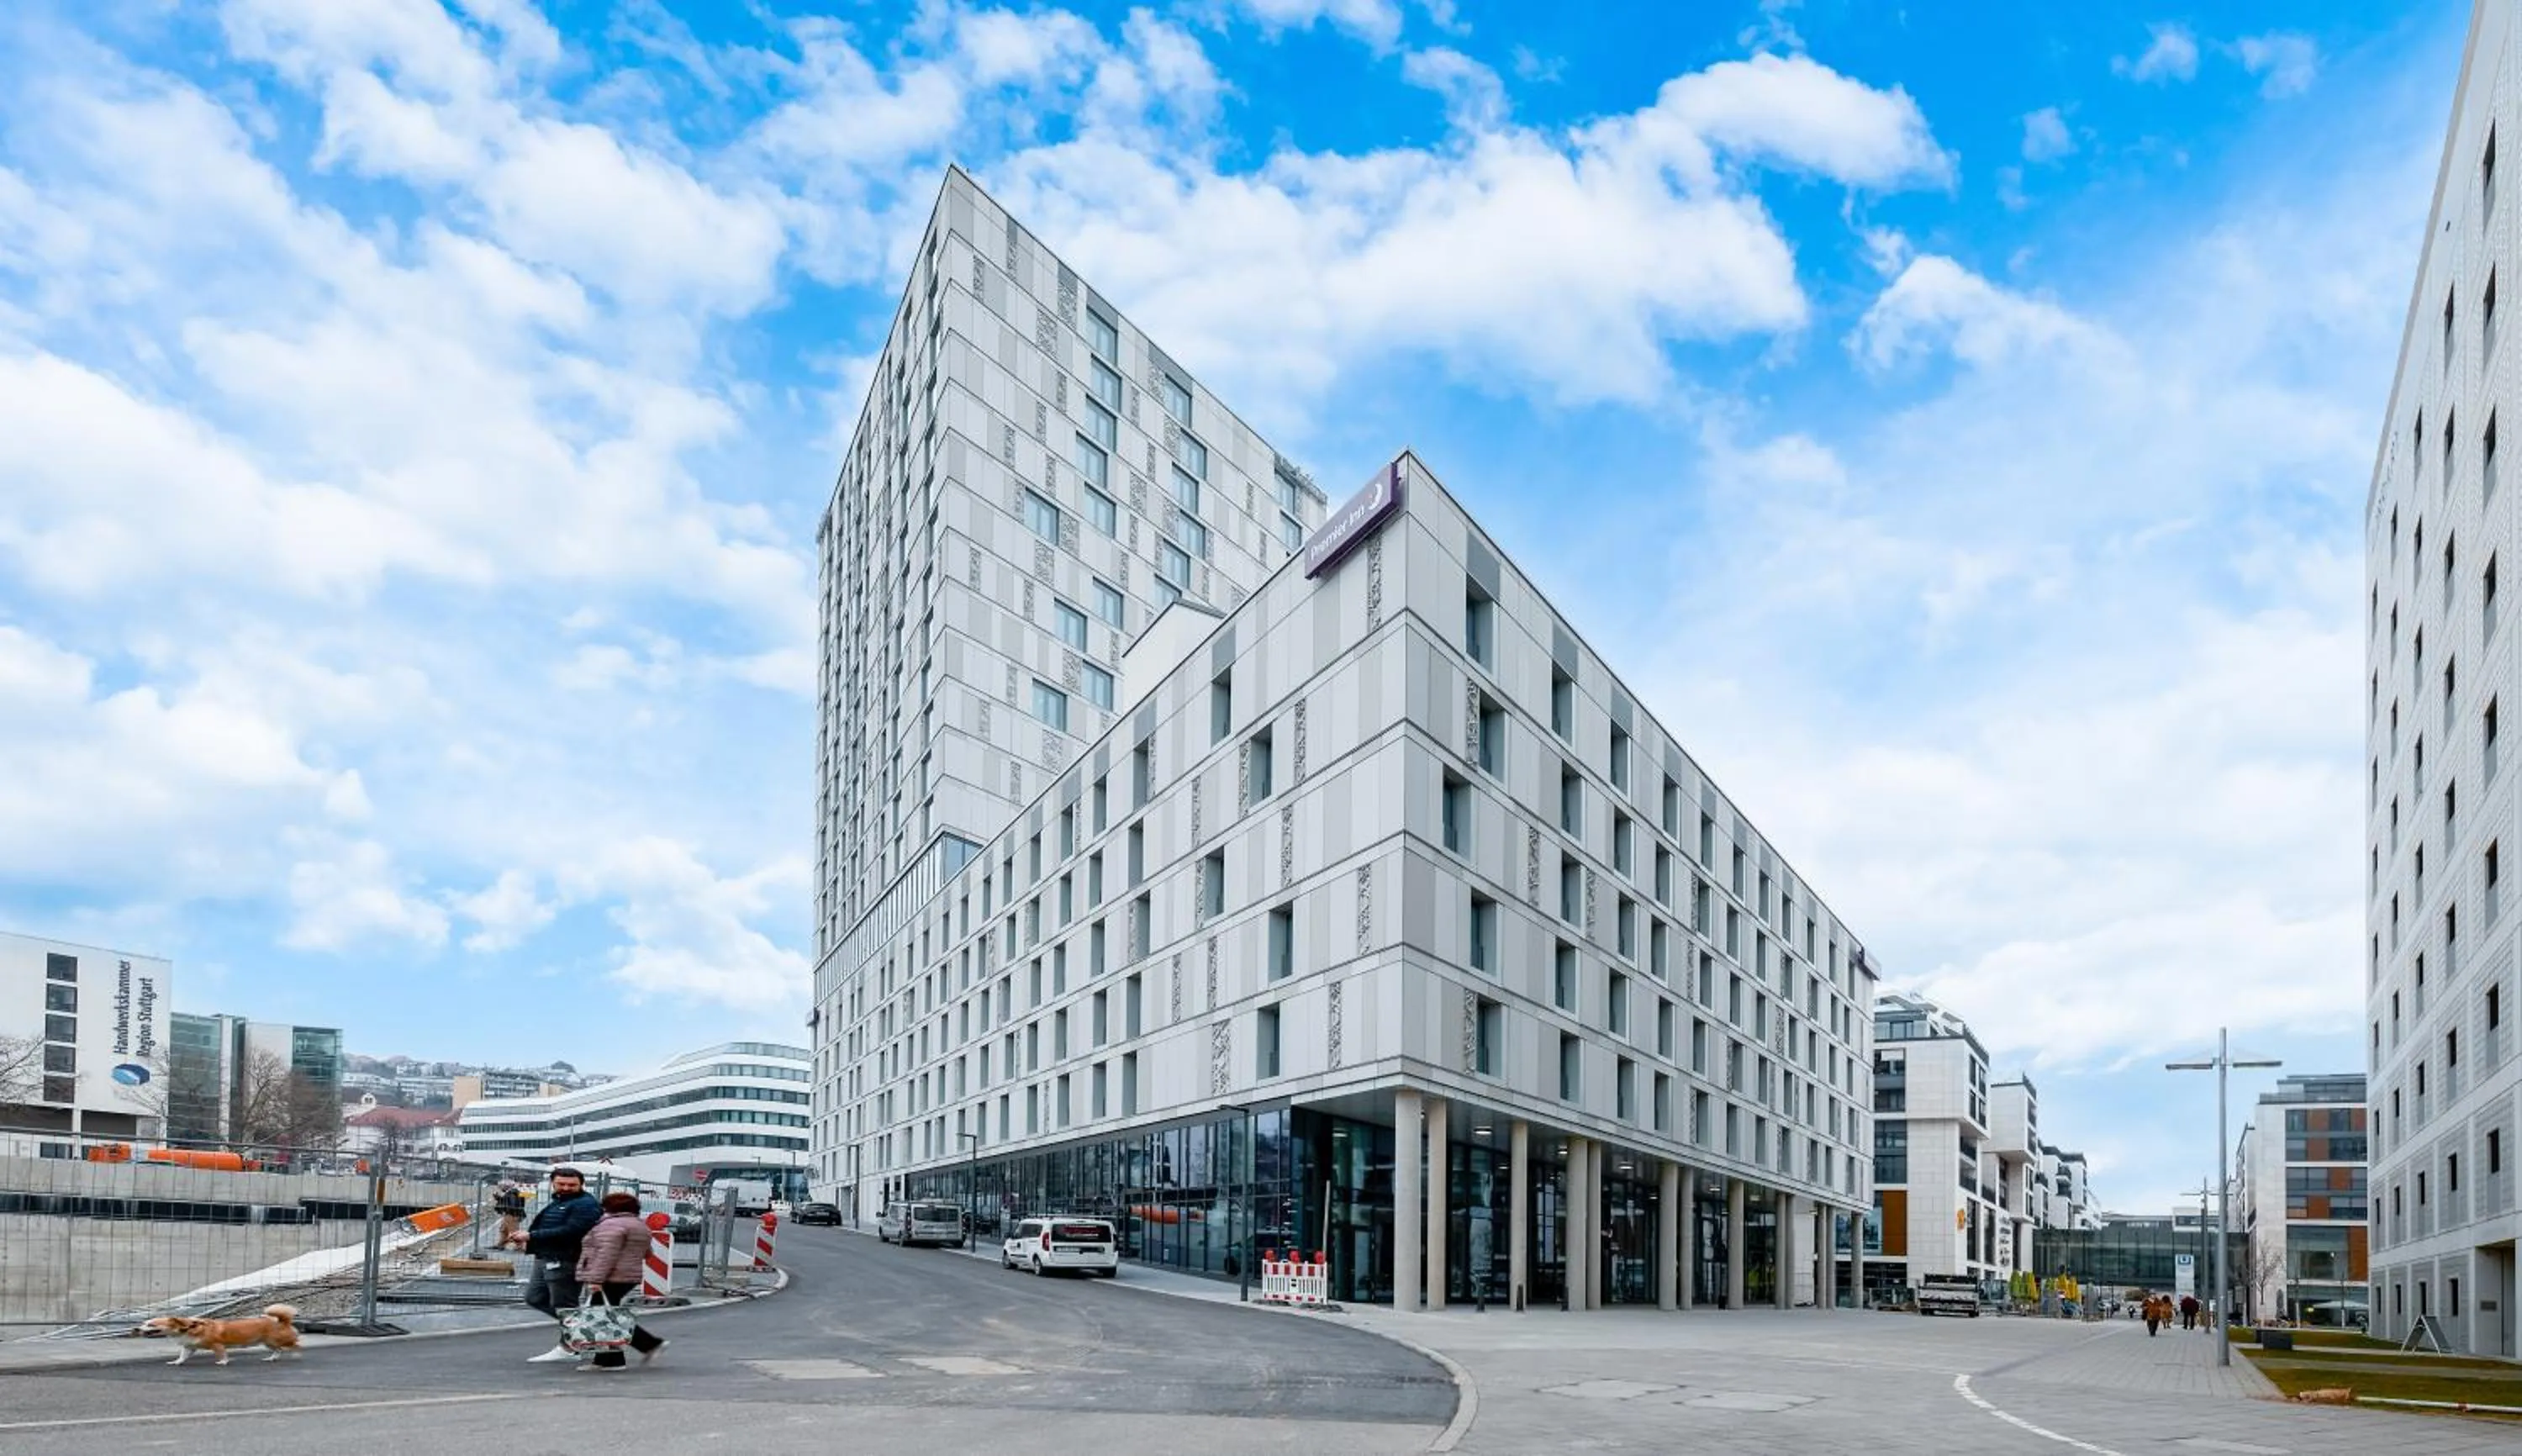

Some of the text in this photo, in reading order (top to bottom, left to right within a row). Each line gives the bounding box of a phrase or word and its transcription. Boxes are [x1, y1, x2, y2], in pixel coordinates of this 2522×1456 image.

[113, 959, 130, 1054] Handwerkskammer
[136, 978, 157, 1057] Region Stuttgart
